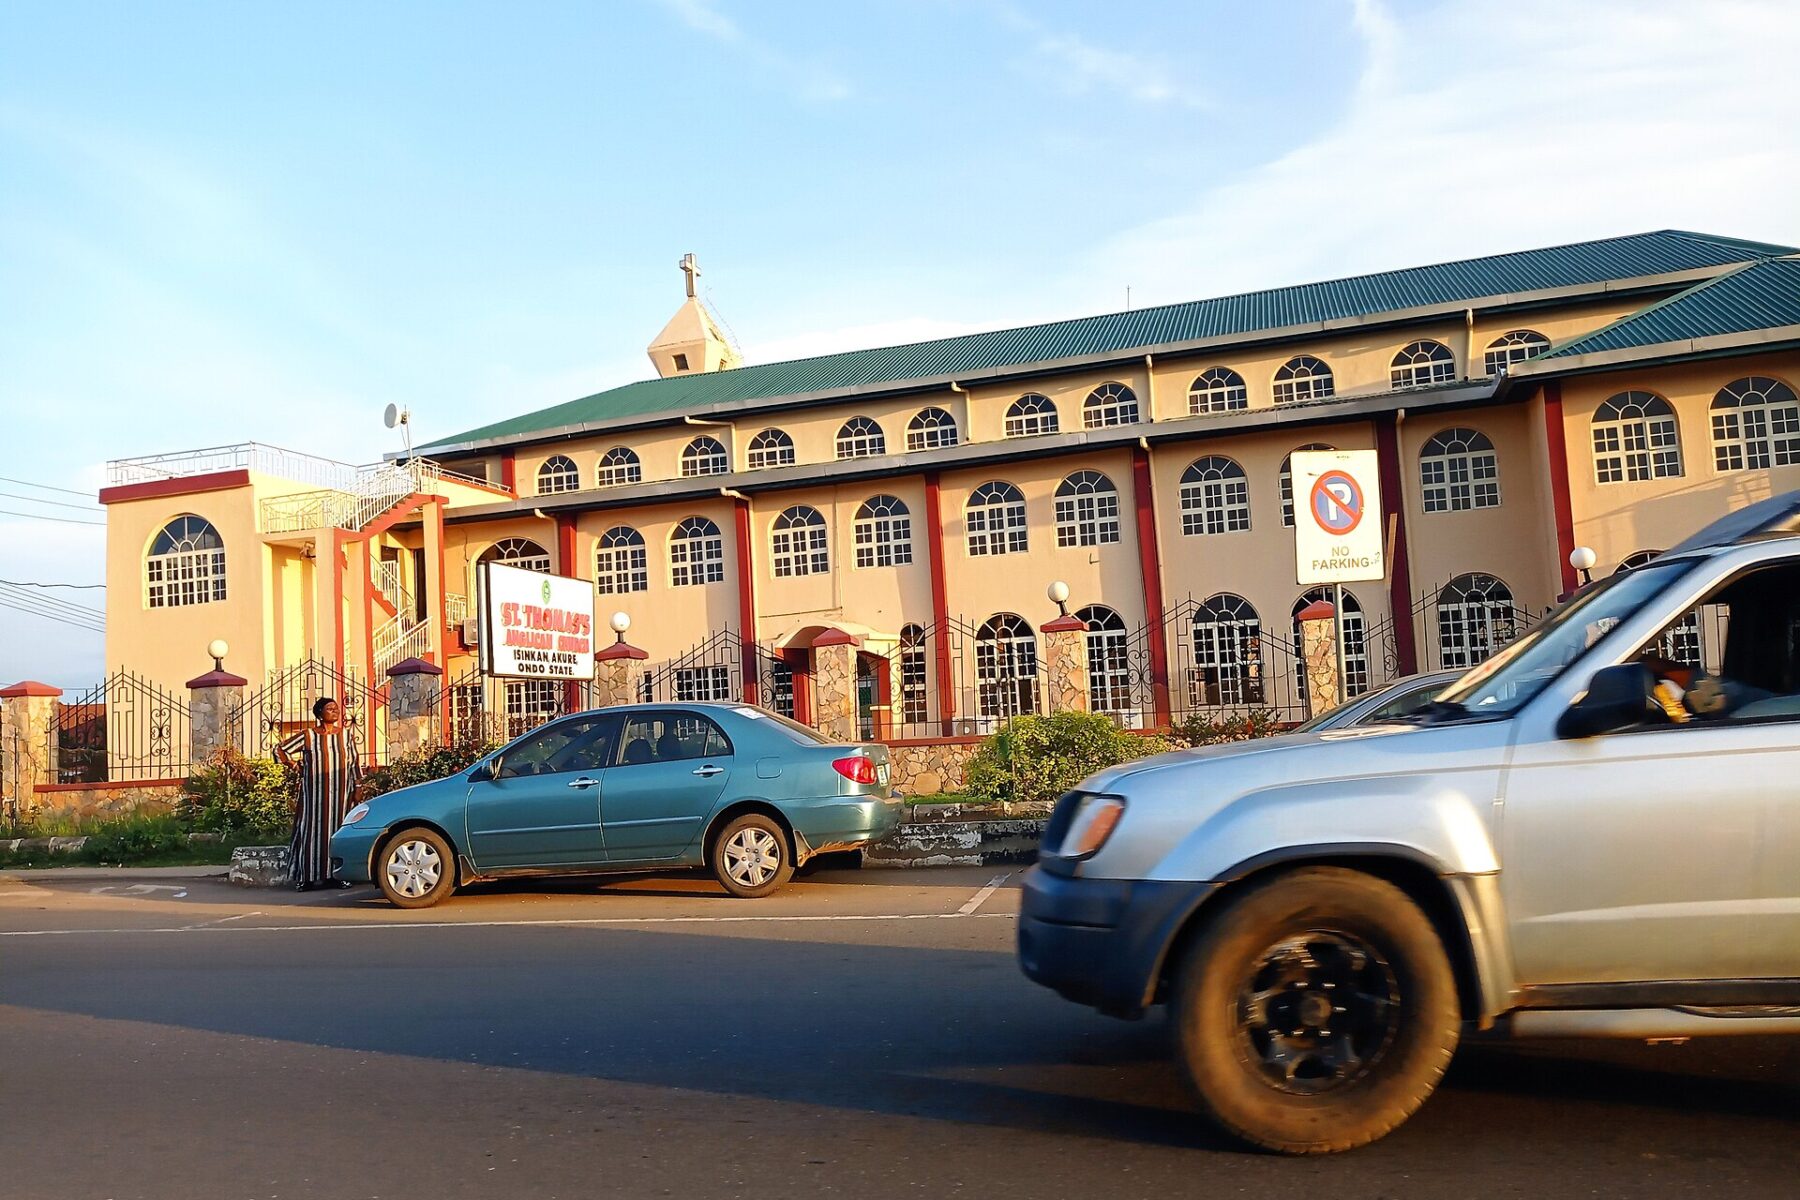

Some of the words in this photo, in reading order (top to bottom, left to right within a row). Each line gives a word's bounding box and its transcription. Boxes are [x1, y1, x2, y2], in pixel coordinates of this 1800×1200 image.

[1331, 546, 1350, 557] NO
[501, 602, 522, 627] ST.
[522, 604, 590, 636] THOMAS'S
[503, 629, 553, 650] ANGLICAN
[558, 635, 589, 654] CHURCH
[518, 663, 545, 674] ONDO
[549, 665, 574, 676] STATE.
